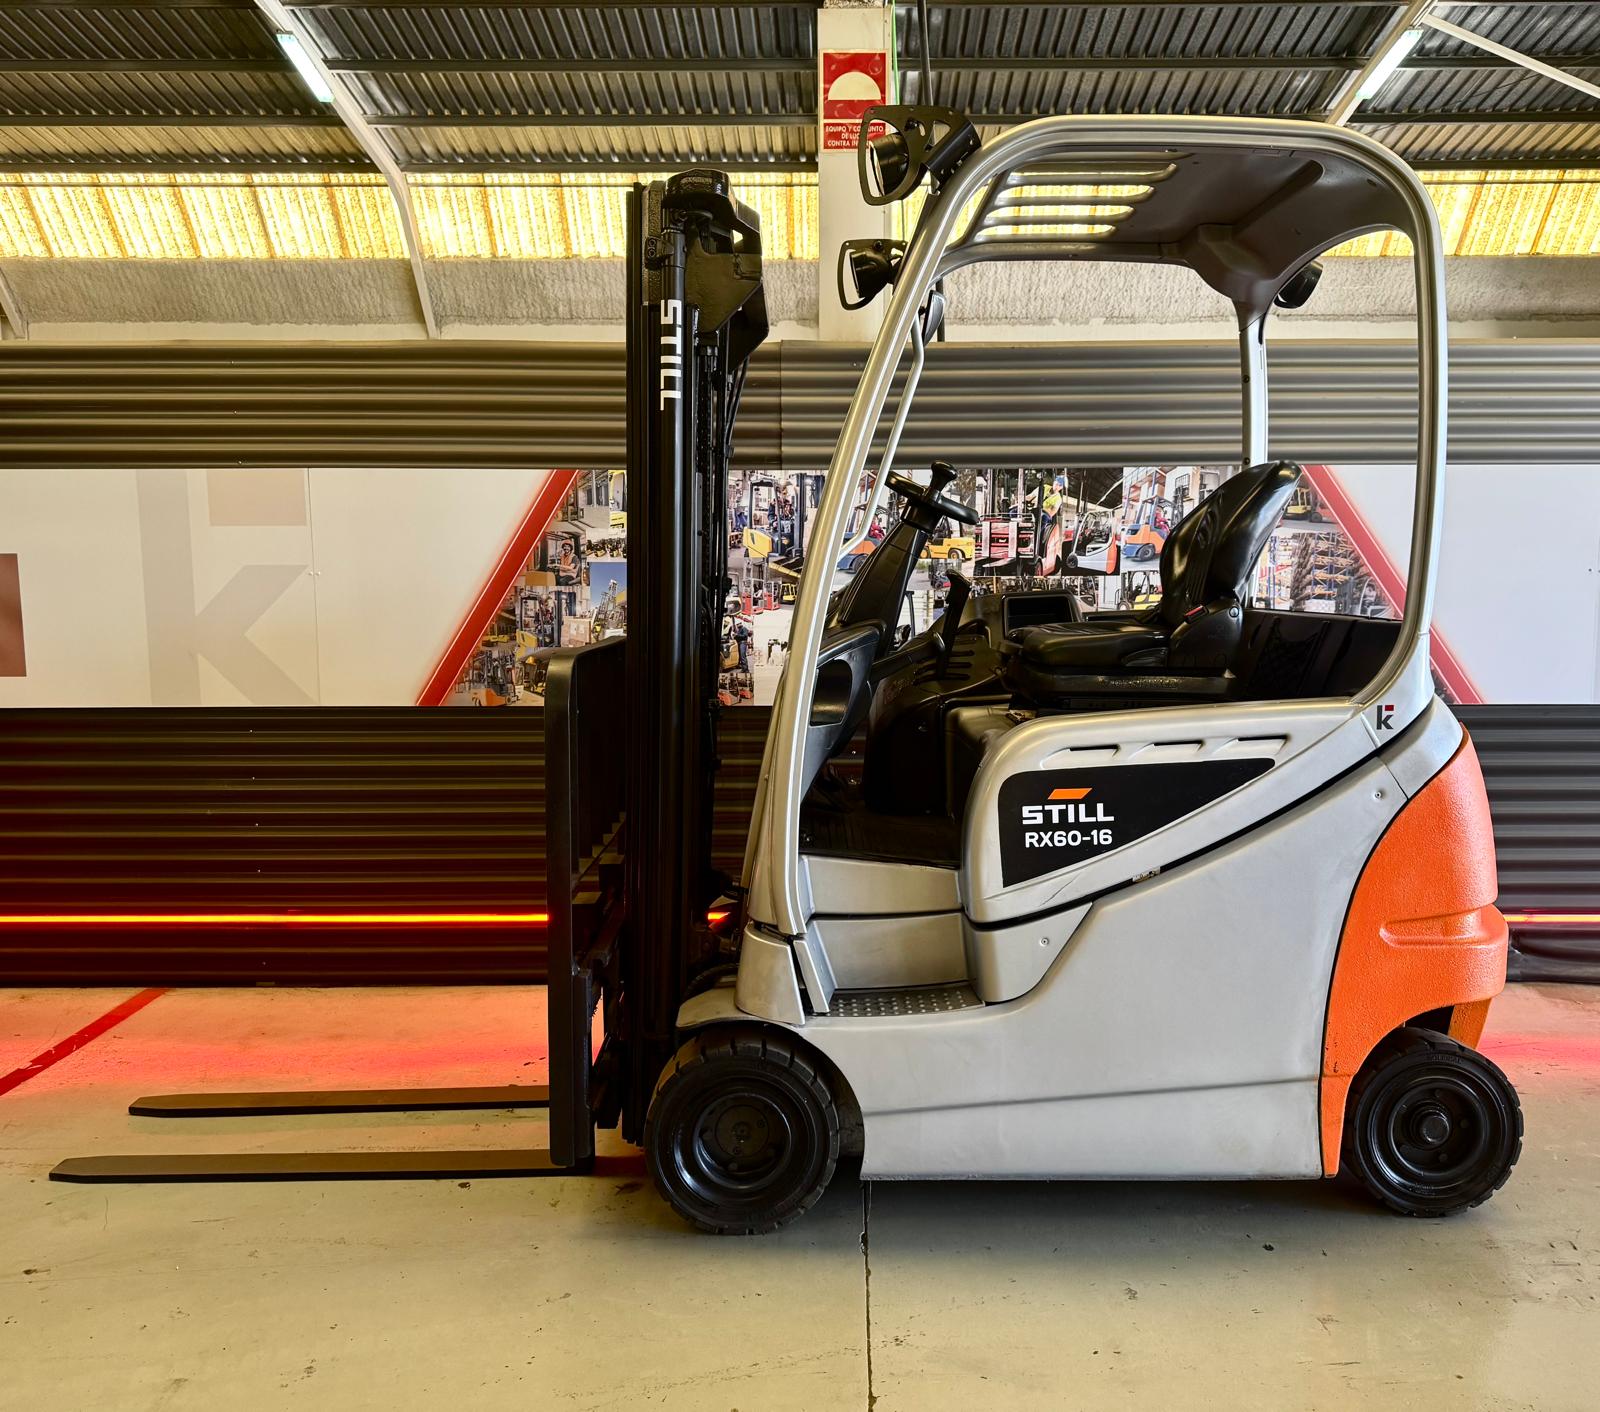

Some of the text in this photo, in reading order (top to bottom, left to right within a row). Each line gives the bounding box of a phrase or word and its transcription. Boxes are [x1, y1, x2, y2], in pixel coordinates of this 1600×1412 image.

[660, 299, 682, 411] STILL
[1022, 803, 1115, 825] STILL
[1024, 829, 1113, 848] RX60-16
